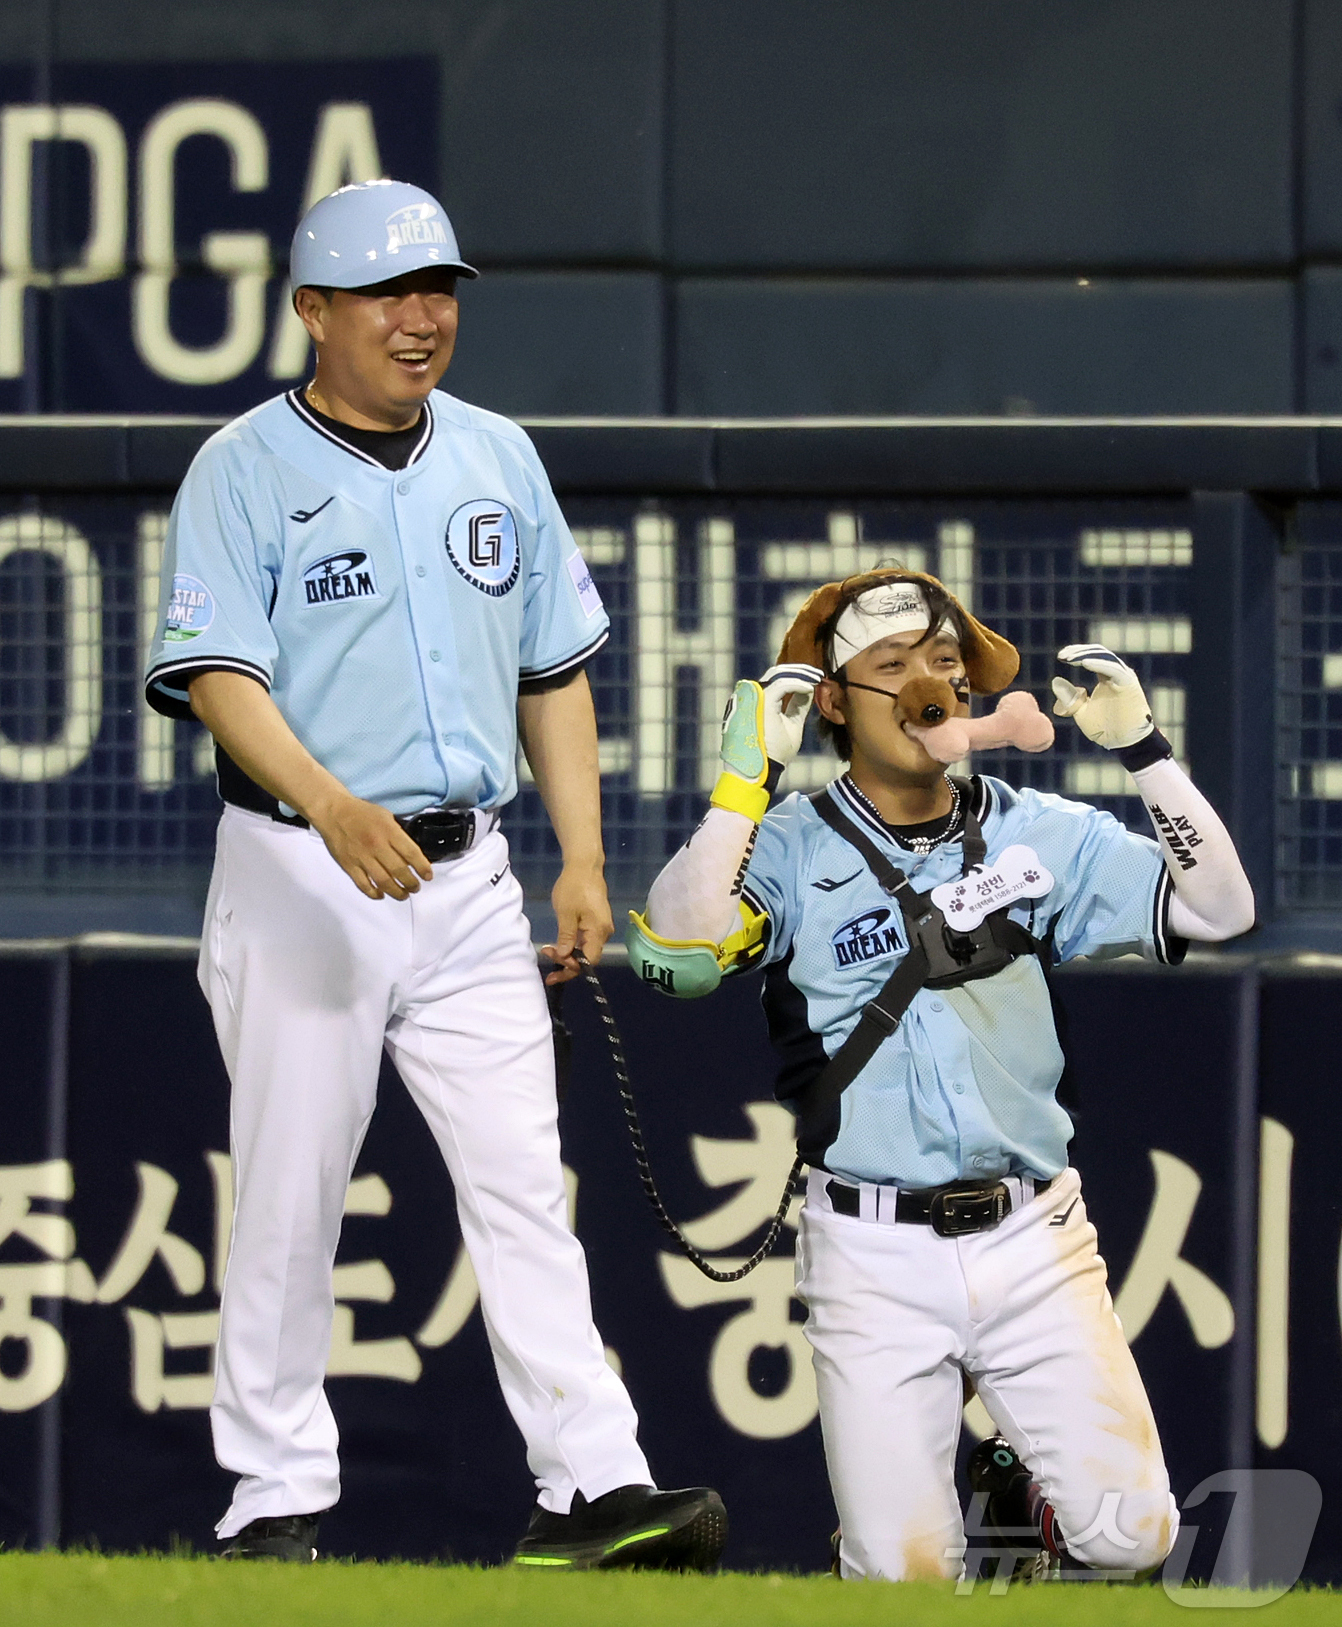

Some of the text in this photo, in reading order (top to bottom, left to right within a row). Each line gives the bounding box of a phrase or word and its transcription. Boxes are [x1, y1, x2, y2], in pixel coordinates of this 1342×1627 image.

[386, 219, 448, 250] DREAM
[173, 588, 207, 608] STAR
[304, 571, 376, 604] DREAM
[166, 604, 196, 623] AME
[1148, 803, 1198, 871] WILLBE
[1171, 814, 1204, 848] PLAY
[976, 873, 1007, 896] 성빈
[834, 926, 904, 967] DREAM
